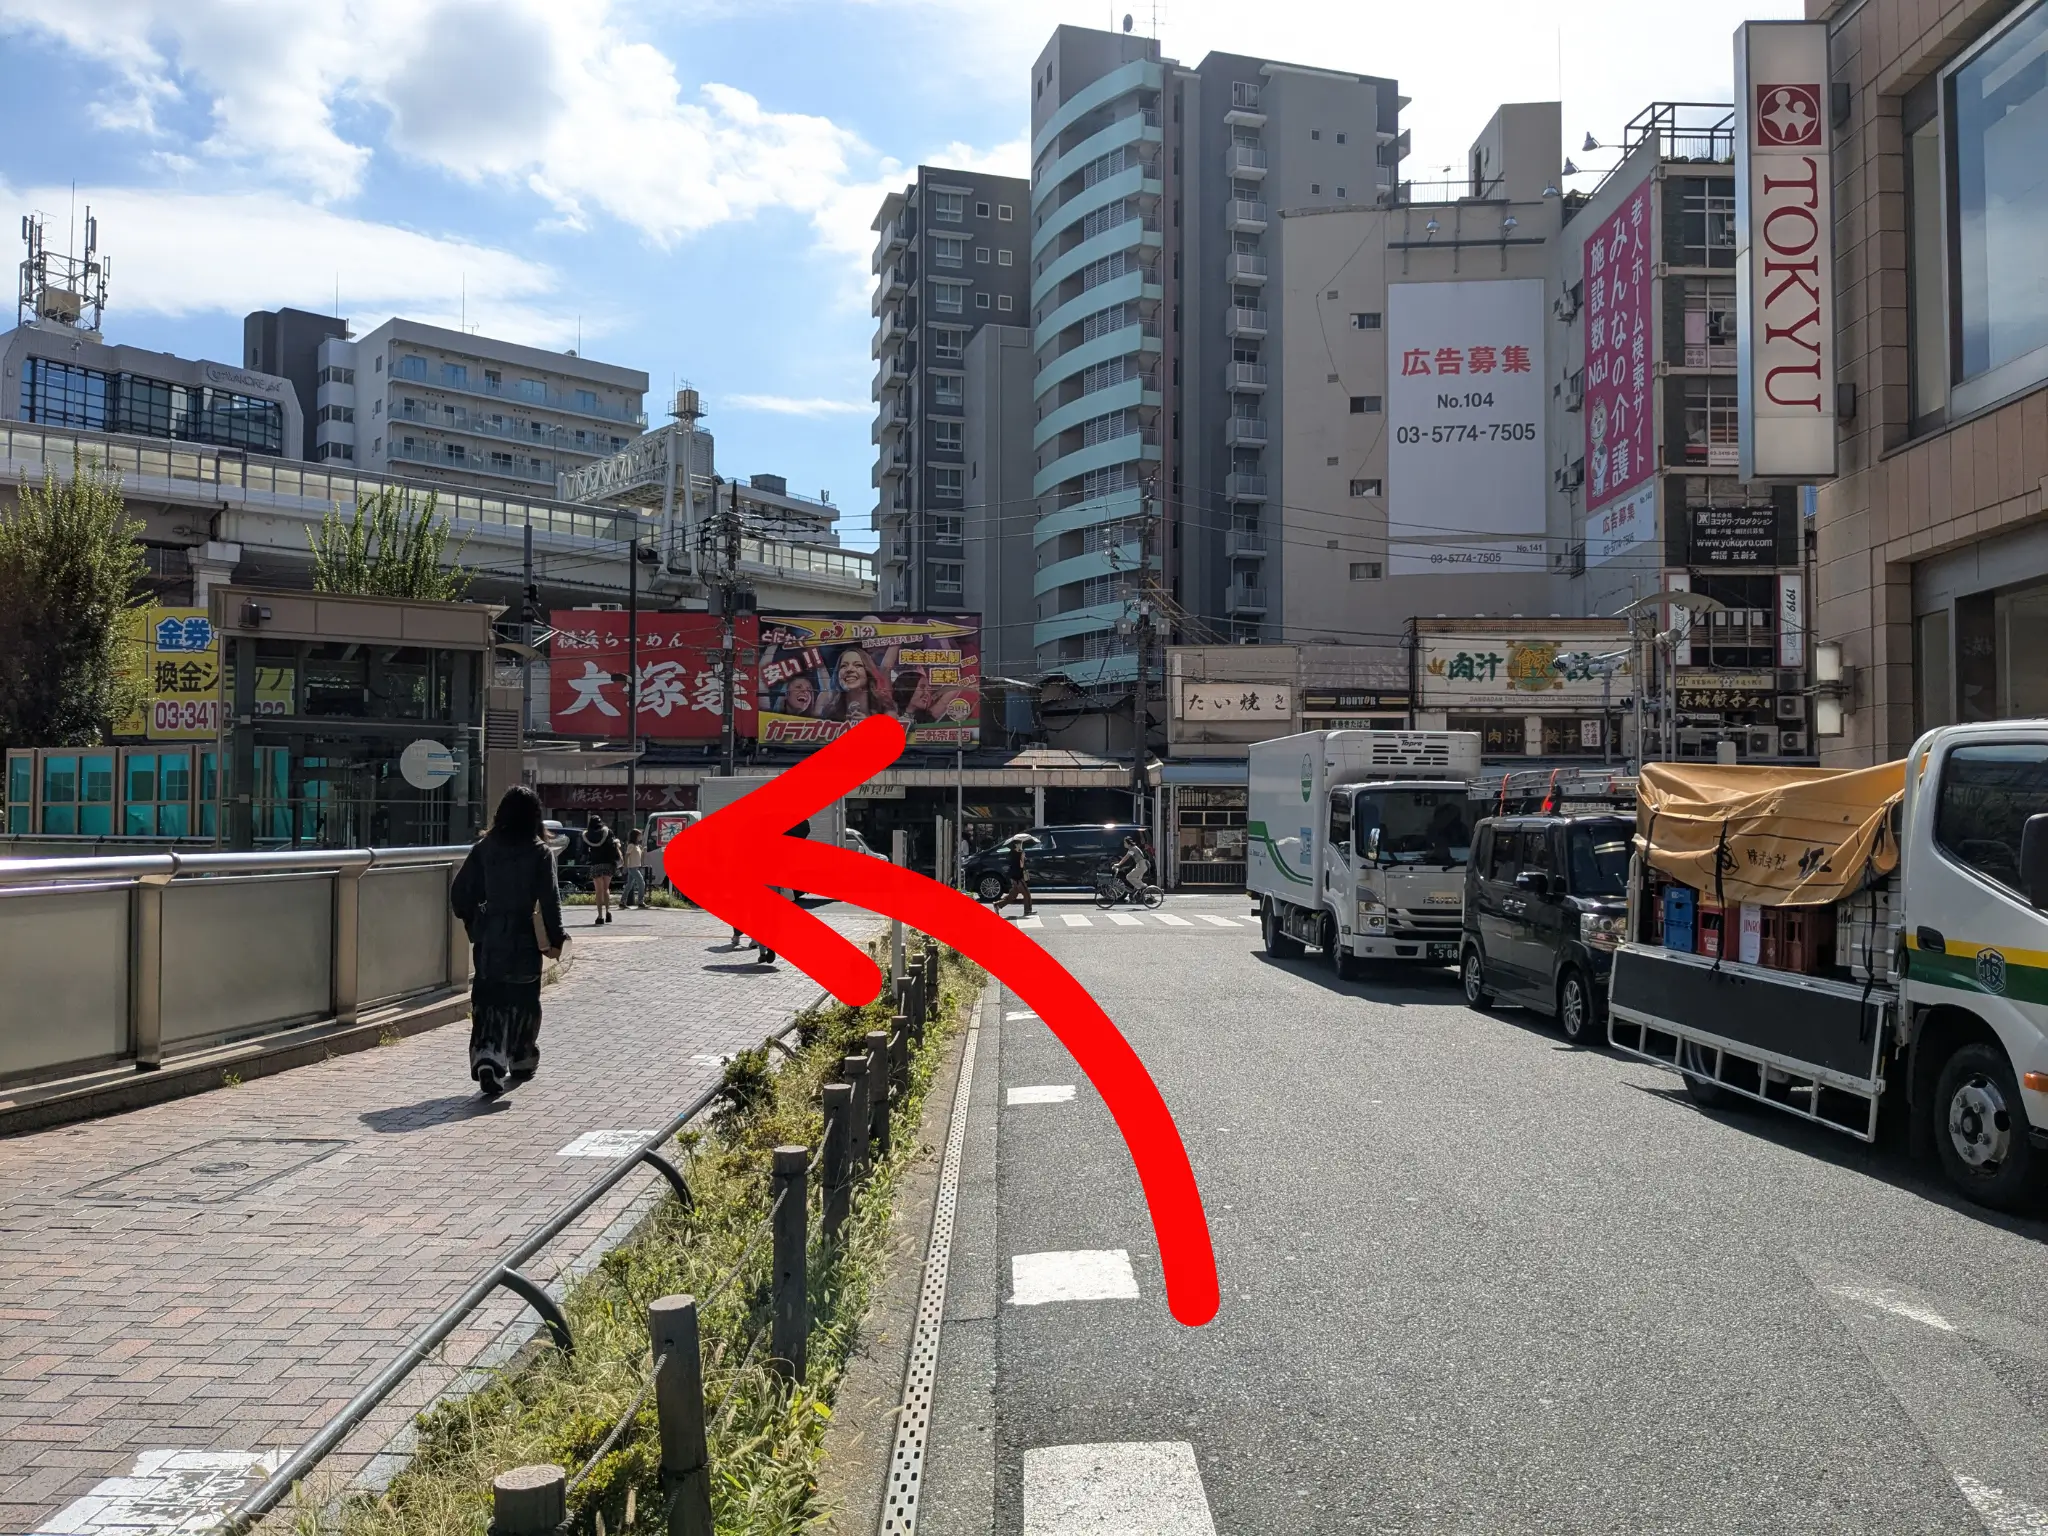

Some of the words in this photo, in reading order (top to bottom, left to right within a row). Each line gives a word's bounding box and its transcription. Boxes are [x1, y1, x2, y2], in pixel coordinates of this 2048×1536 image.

[1763, 157, 1822, 412] TOKYU
[1590, 237, 1605, 354] 施設数
[1631, 195, 1645, 474] 老人ホーム検索サイト
[1401, 346, 1531, 376] 広告募集
[1609, 216, 1630, 488] みんなの介護
[1437, 392, 1494, 408] No.104
[1397, 423, 1536, 444] 03-5774-7505
[1516, 544, 1543, 553] No.141
[1697, 538, 1773, 548] www.yokopro.com
[1430, 553, 1501, 564] 03-5774-7505
[1786, 588, 1796, 612] 1919
[155, 616, 213, 653] 金券
[557, 629, 684, 650] 横浜らーめん
[901, 650, 960, 664] 完全持込制
[1447, 651, 1505, 683] 肉汁
[930, 668, 959, 684] 室料
[556, 660, 752, 718] 大塚家
[1188, 691, 1287, 711] たい焼き
[1340, 695, 1376, 706] DOUTOR
[915, 730, 971, 742] 三軒茶屋店
[1401, 739, 1423, 747] Topre
[1487, 729, 1522, 744] 肉汁
[1544, 729, 1579, 744] 餃子
[1422, 896, 1462, 905] ISUZU
